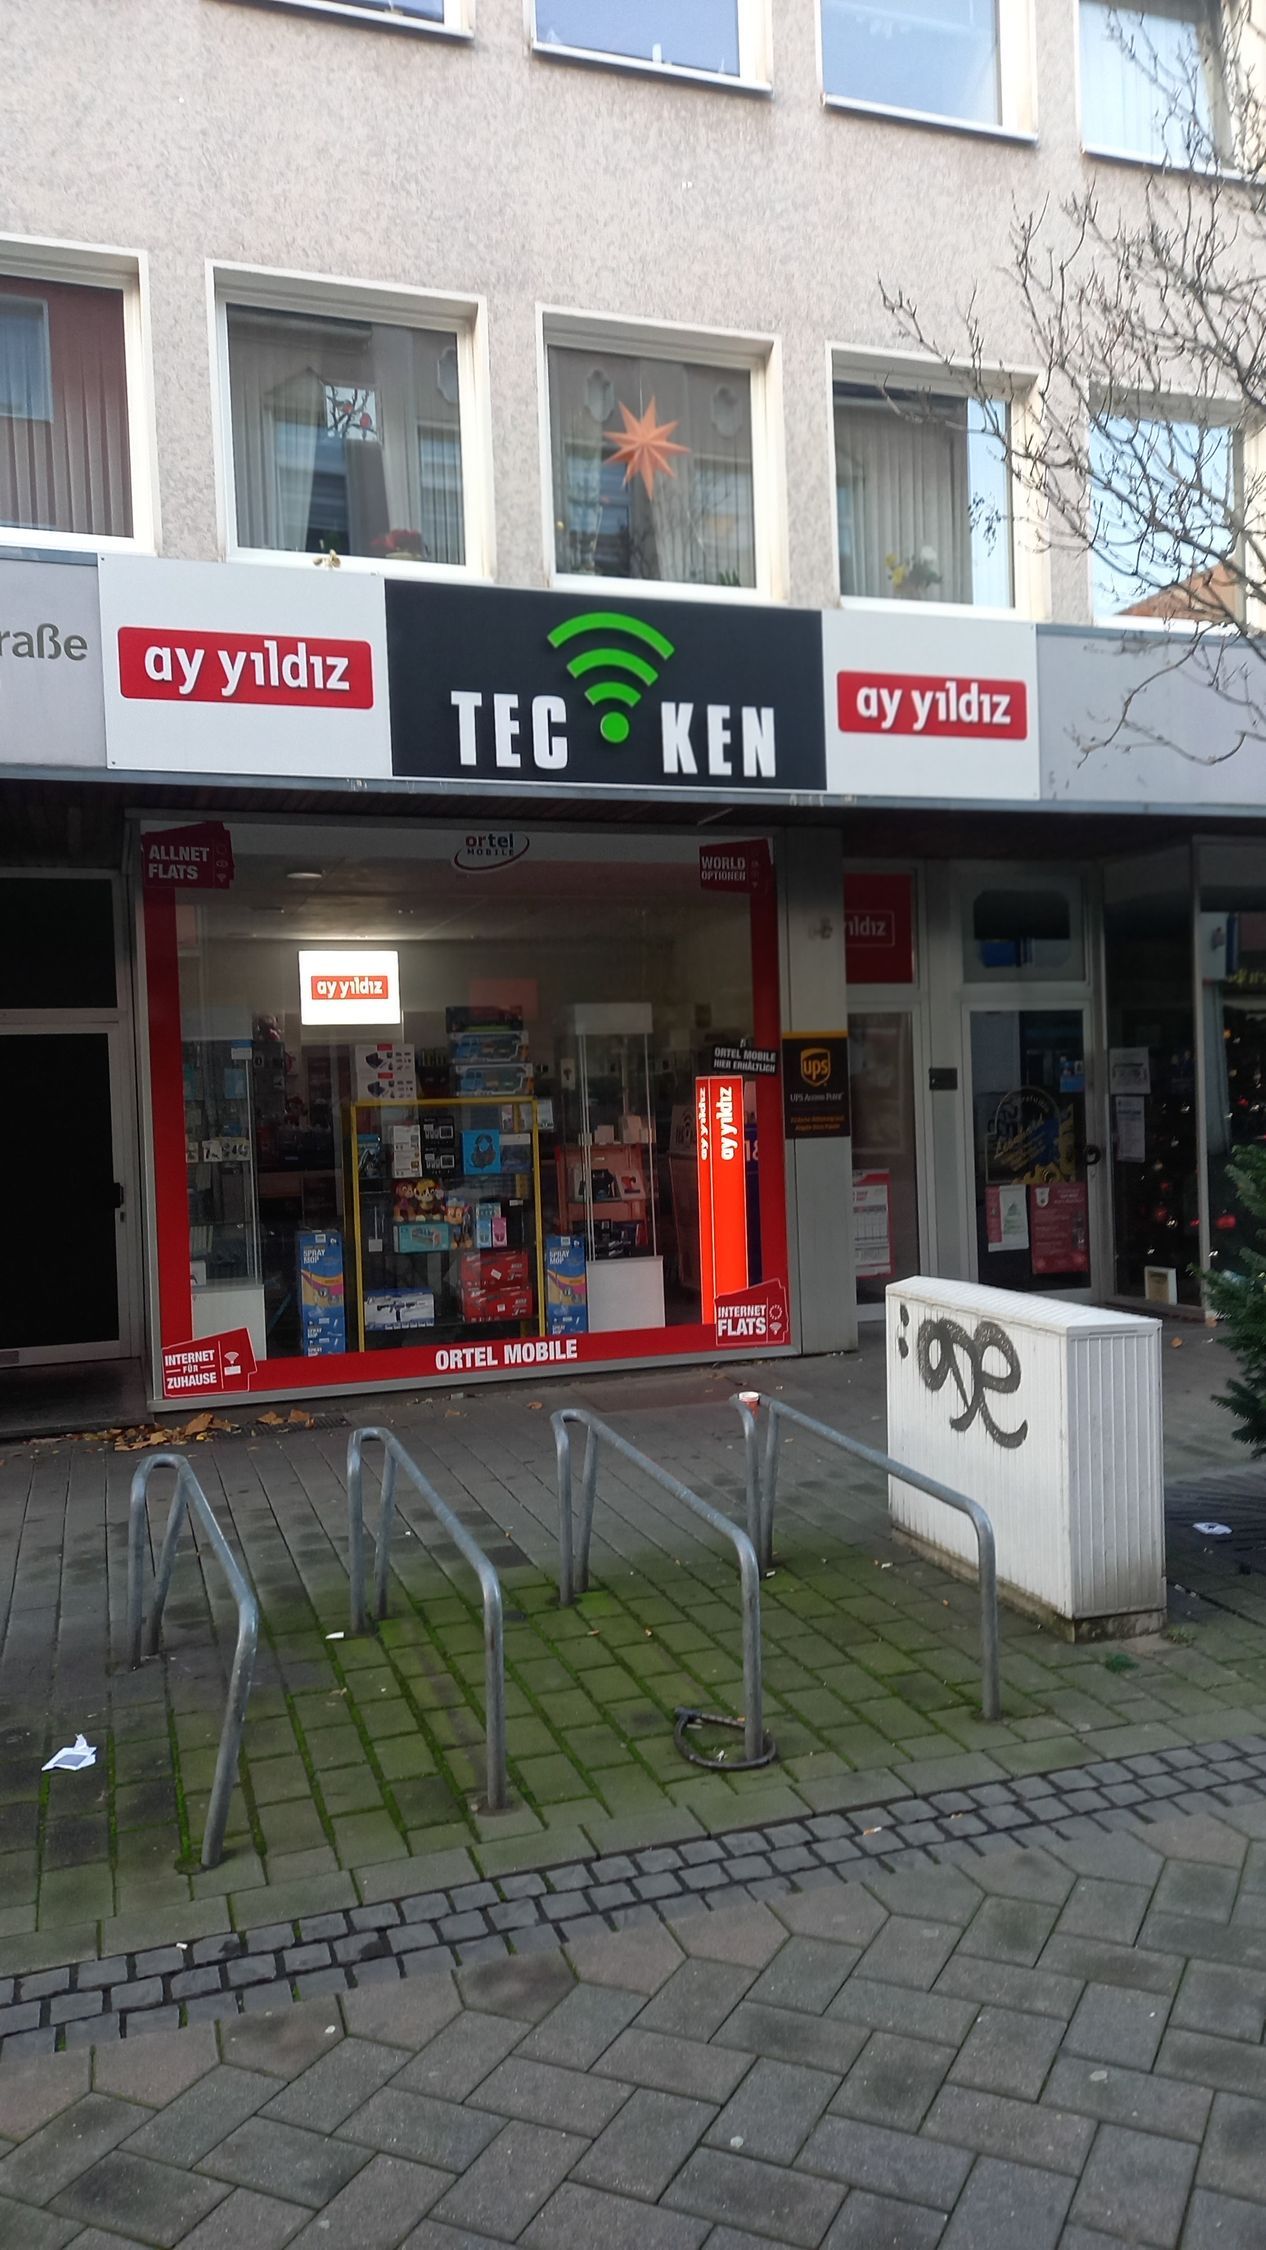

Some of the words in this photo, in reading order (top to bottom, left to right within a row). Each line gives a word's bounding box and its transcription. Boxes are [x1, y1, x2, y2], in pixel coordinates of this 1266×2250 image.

[145, 646, 205, 695] ay
[221, 640, 350, 697] yıldız
[857, 686, 902, 730] ay
[911, 681, 1011, 731] yıldız
[451, 691, 568, 769] TEC
[661, 702, 776, 778] KEN
[466, 833, 513, 848] ortel
[149, 845, 209, 862] ALLNET
[149, 863, 198, 880] FLATS
[701, 856, 746, 870] WORLD
[701, 871, 746, 881] OPTIONEN
[845, 915, 886, 937] ıldız
[317, 979, 336, 998] ay
[713, 1058, 731, 1069] HIER
[714, 1047, 741, 1059] ORTEL
[743, 1049, 776, 1063] MOBILE
[803, 1058, 829, 1080] ups
[720, 1137, 738, 1161] ay
[718, 1304, 766, 1318] INTERNET
[717, 1317, 767, 1337] FLATS
[165, 1349, 215, 1367] INTERNET
[435, 1346, 498, 1371] ORTEL
[504, 1339, 577, 1364] MOBILE
[183, 1363, 199, 1374] FÜR
[166, 1373, 217, 1389] ZUHAUSE
